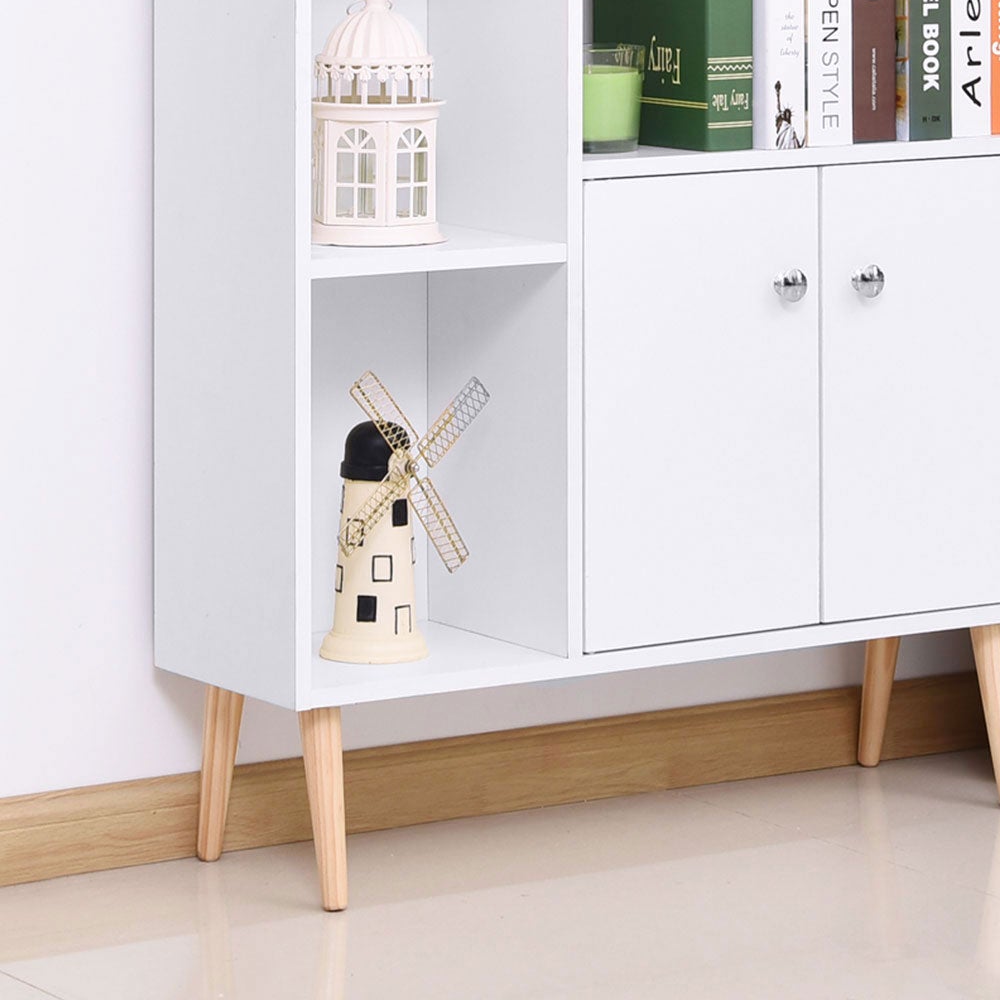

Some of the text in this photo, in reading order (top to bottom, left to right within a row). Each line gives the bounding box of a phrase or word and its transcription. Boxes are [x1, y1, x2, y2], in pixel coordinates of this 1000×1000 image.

[647, 35, 681, 85] Fairy
[922, 24, 940, 92] BOOK
[711, 88, 749, 113] Fairy Tale
[821, 51, 840, 130] STYLE
